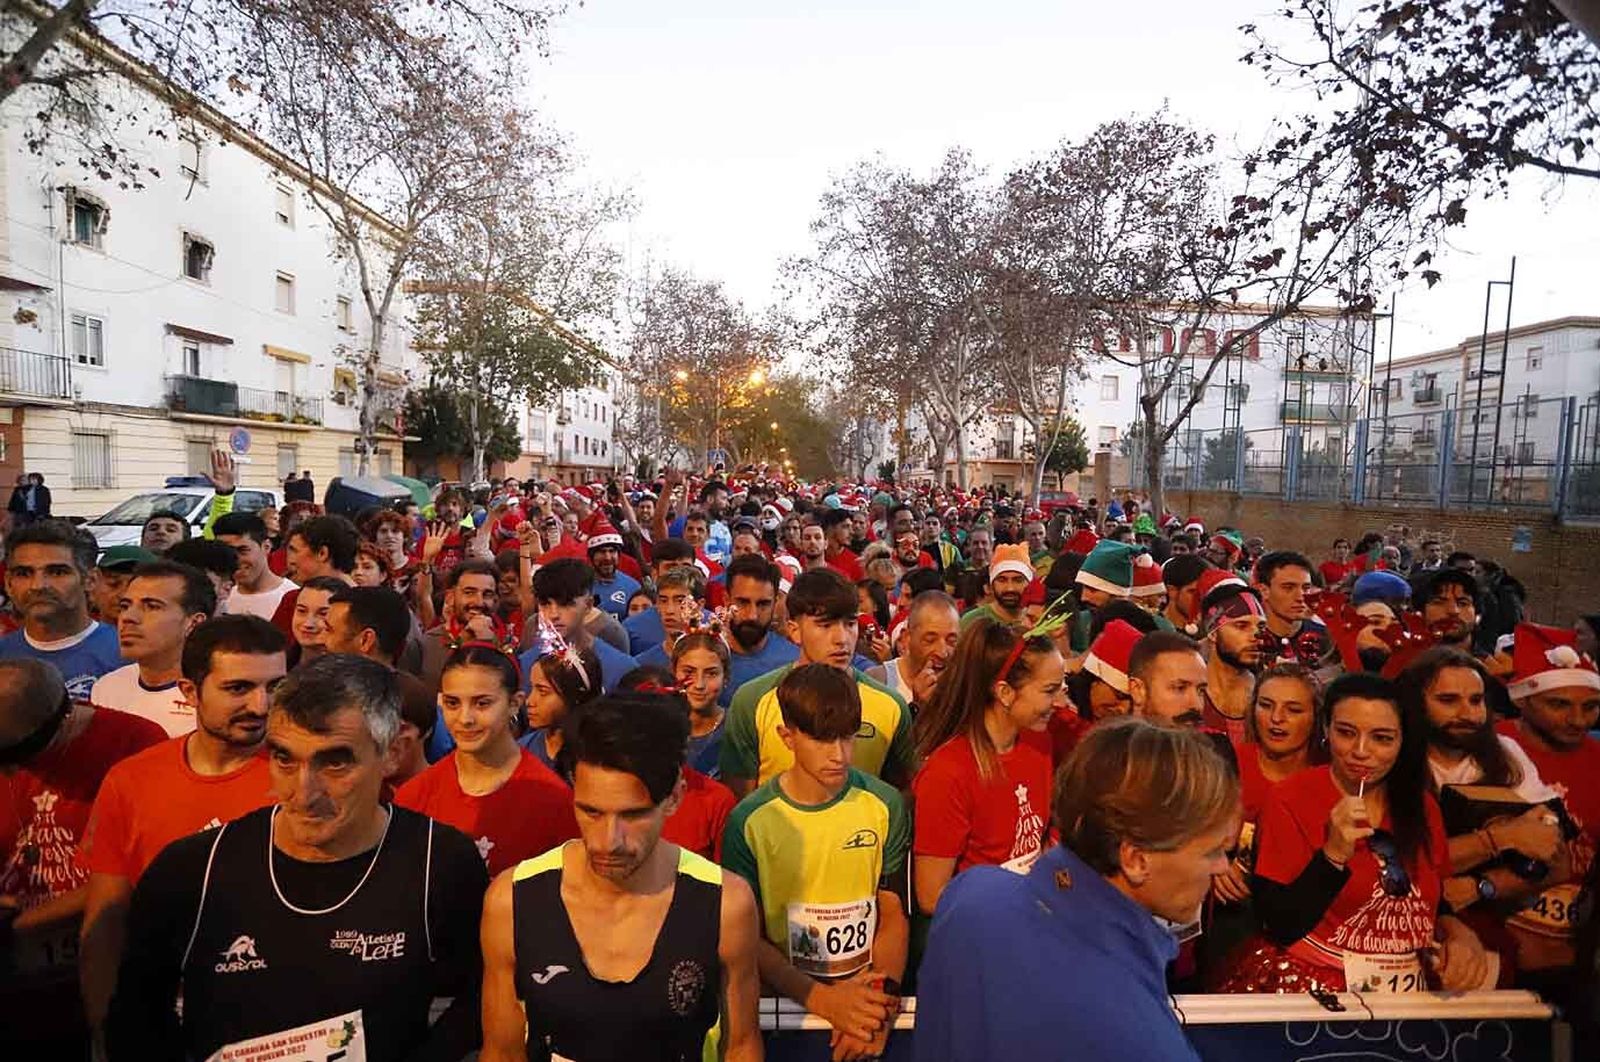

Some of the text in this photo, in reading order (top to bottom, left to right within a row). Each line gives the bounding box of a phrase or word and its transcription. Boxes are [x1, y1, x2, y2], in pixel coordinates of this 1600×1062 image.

[1376, 910, 1434, 932] Huelva
[826, 921, 867, 955] 628
[235, 1043, 270, 1057] CARRERA
[271, 1039, 287, 1049] SAN
